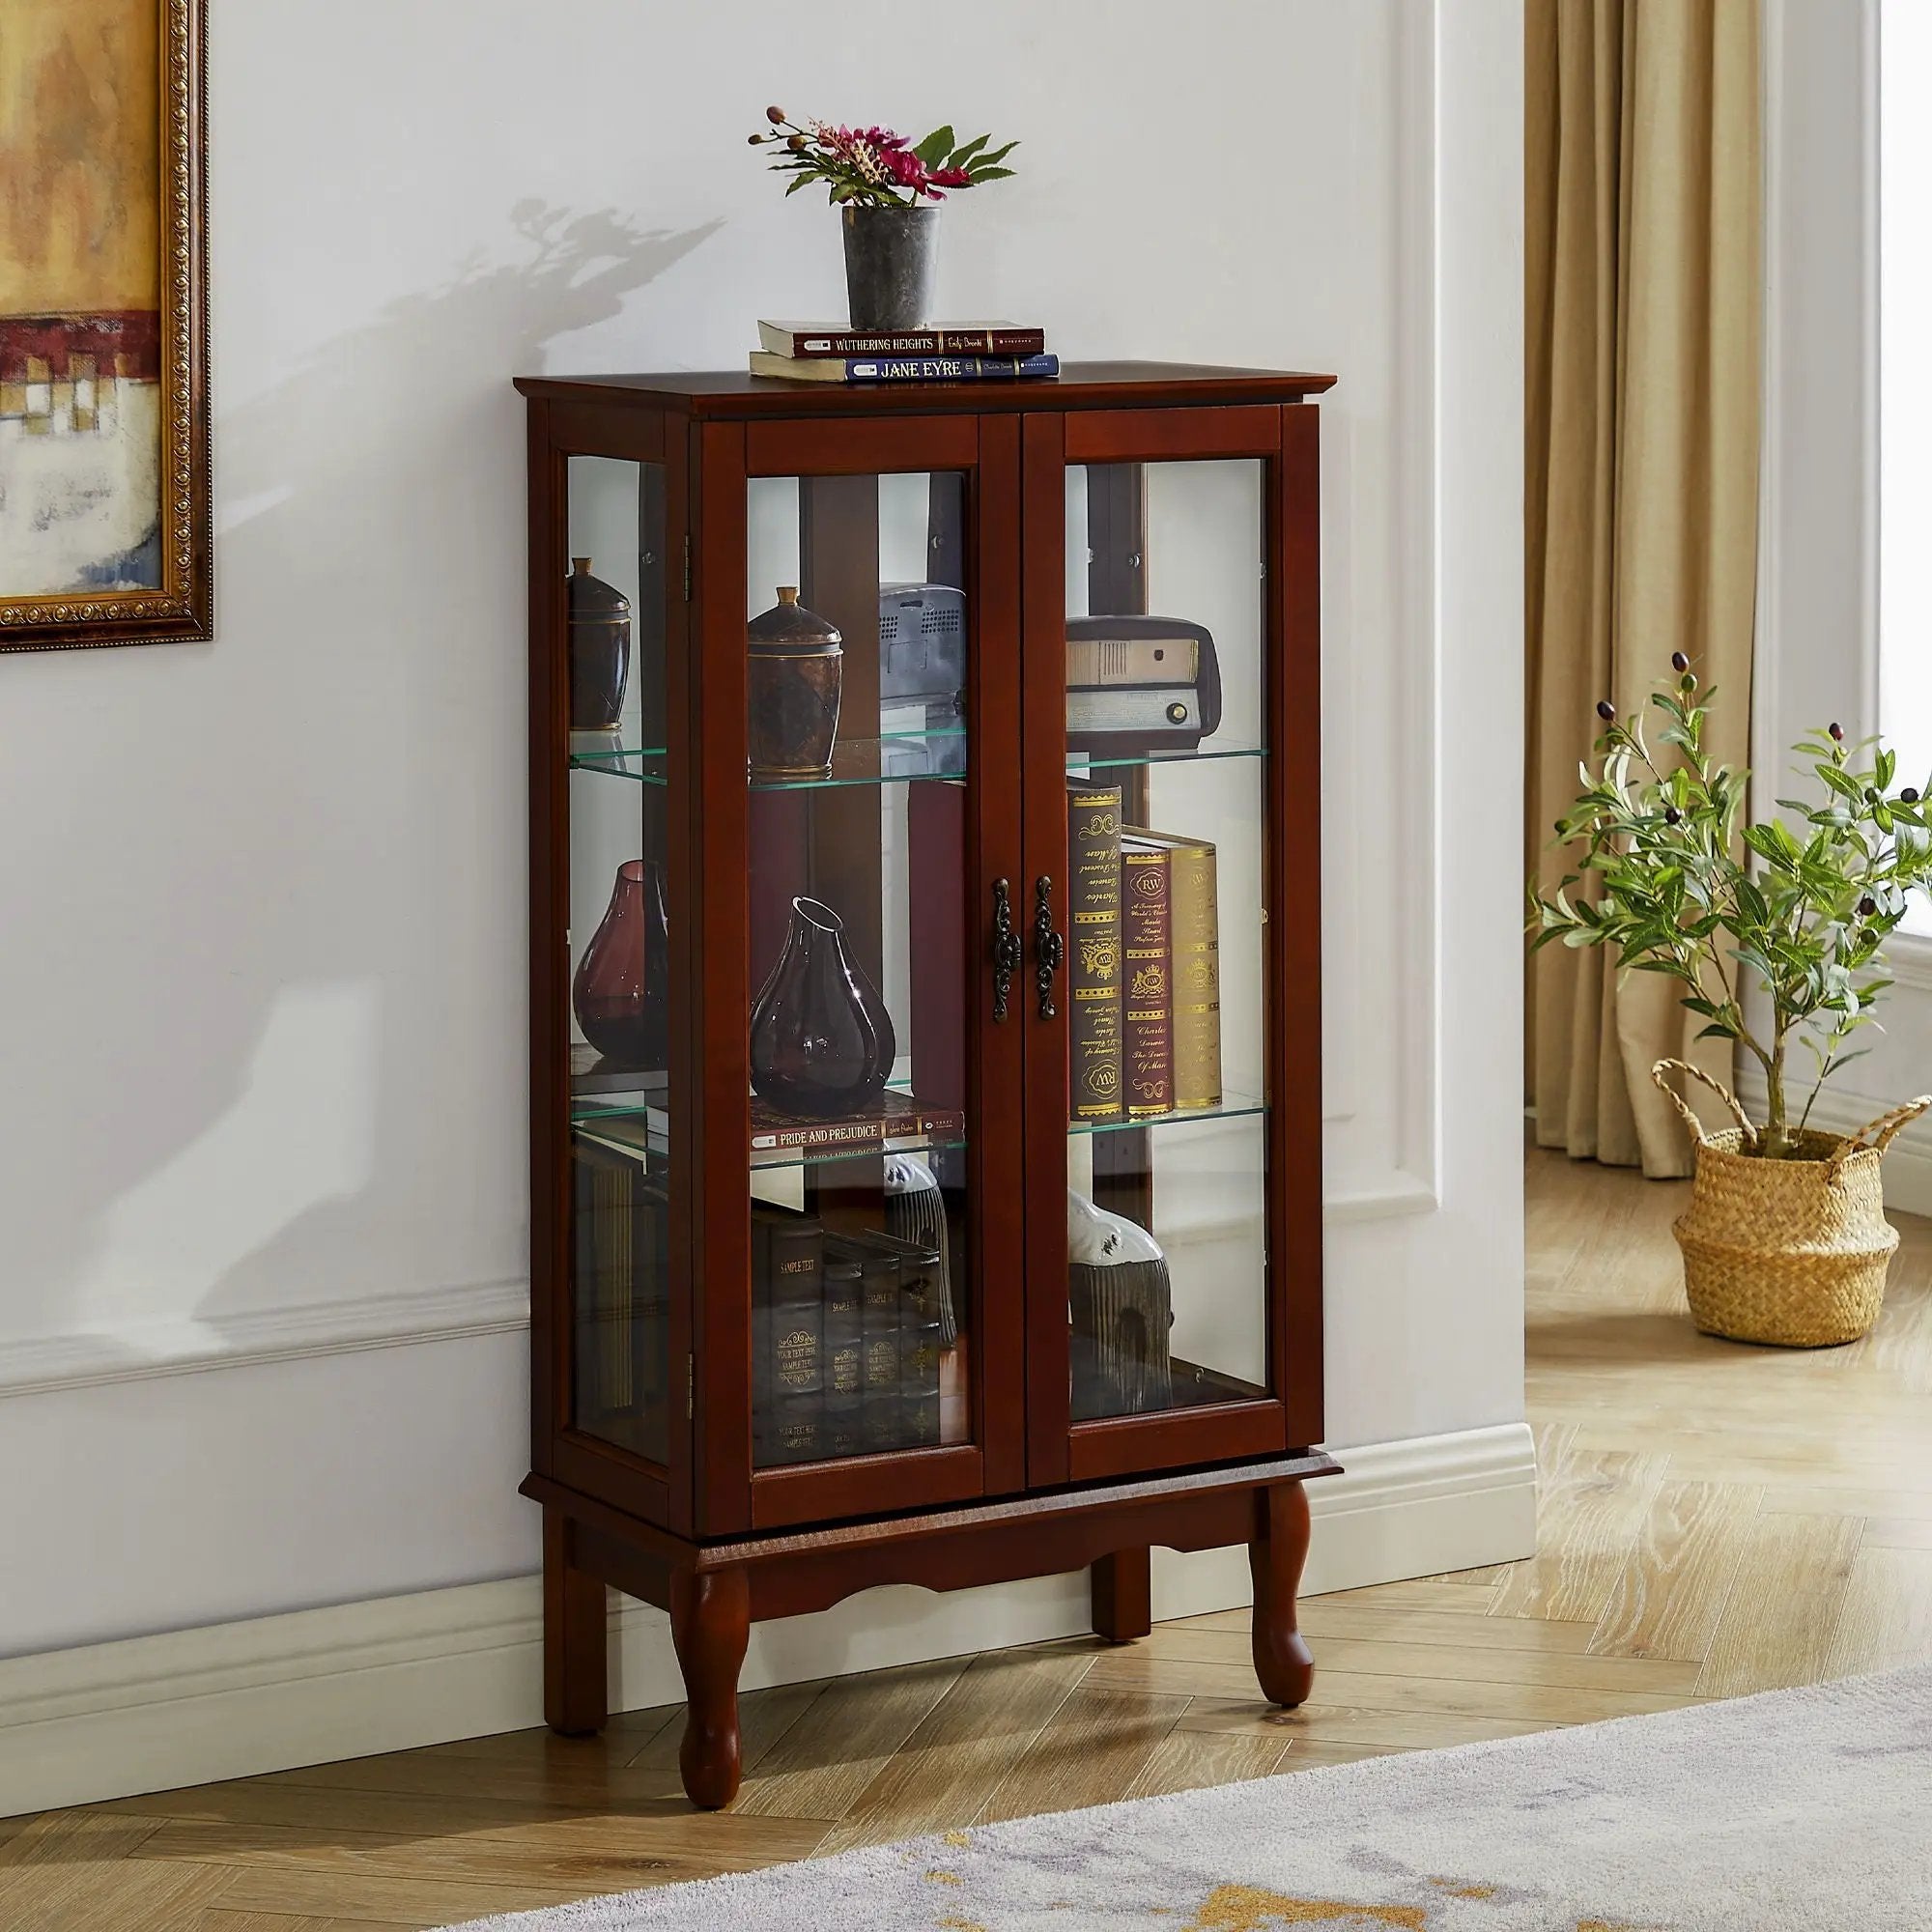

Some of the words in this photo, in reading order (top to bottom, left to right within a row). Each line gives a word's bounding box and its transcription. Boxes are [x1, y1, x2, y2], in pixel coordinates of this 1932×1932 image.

[836, 338, 891, 352] WUTHERING
[893, 337, 933, 350] HEIGHTS
[881, 363, 920, 378] JANE
[923, 360, 962, 376] EYRE
[1142, 878, 1161, 891] RW
[1096, 1071, 1116, 1085] RW
[780, 1131, 807, 1146] PRIDE
[809, 1128, 828, 1142] AND
[829, 1124, 877, 1141] PREJUDICE
[781, 1260, 802, 1274] SAMPLE
